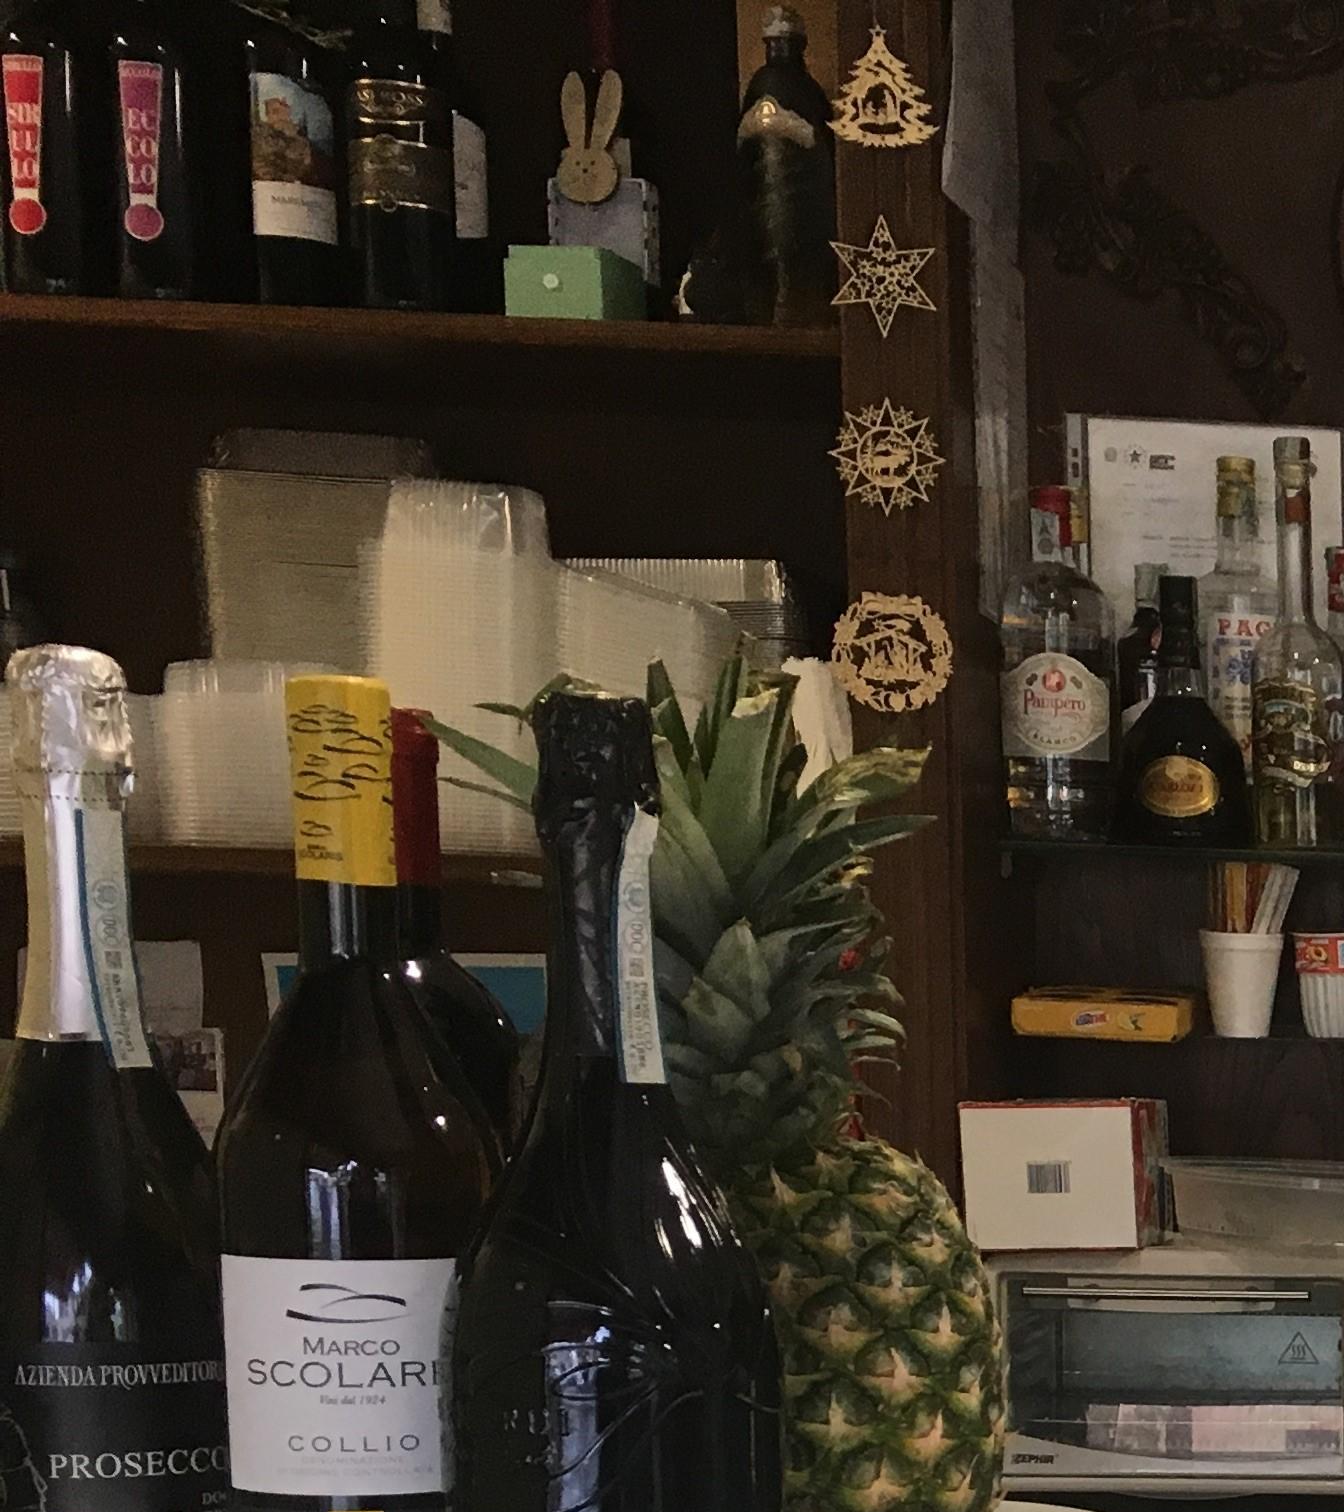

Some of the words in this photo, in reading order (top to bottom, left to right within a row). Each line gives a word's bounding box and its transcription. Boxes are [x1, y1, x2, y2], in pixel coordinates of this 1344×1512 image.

[1023, 688, 1087, 717] Pampero
[302, 1336, 401, 1356] MARCO
[15, 1364, 99, 1387] AZIENDA
[287, 1434, 420, 1453] COLLIO
[48, 1445, 227, 1479] PROSECCO
